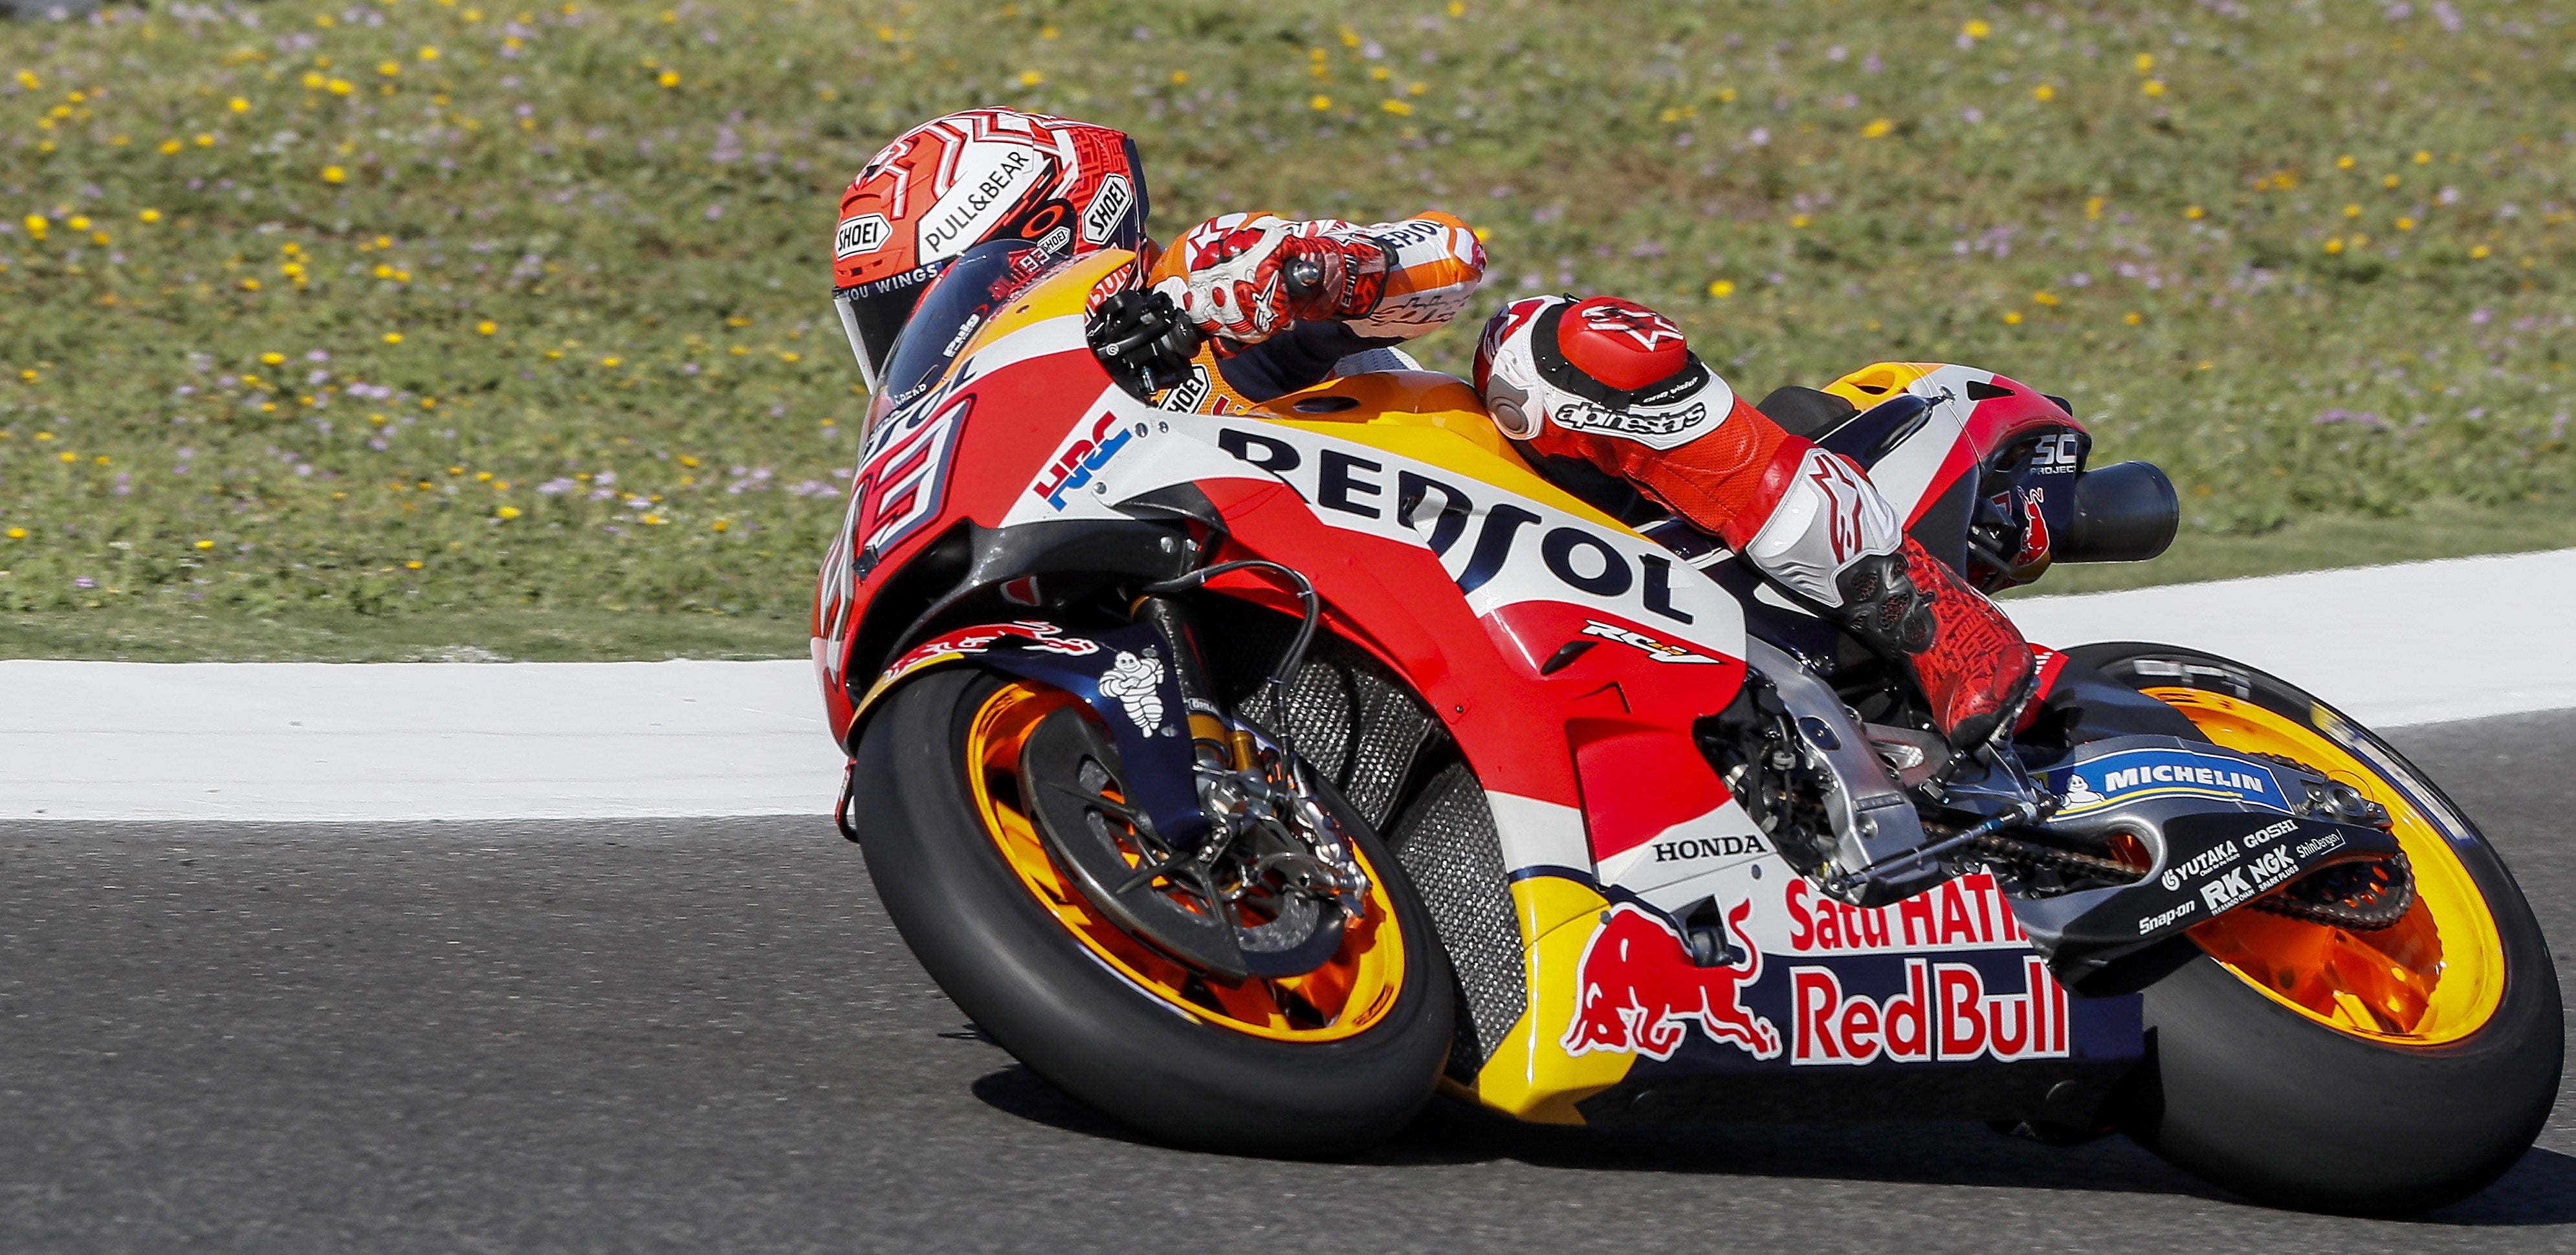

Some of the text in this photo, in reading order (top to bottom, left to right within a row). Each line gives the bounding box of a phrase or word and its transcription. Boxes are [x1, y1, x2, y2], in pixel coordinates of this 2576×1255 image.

[925, 151, 1029, 252] PULL&BEAR
[1090, 180, 1126, 236] SHOEI
[837, 221, 877, 252] SHOEI
[1019, 246, 1050, 272] 93
[875, 265, 938, 294] WINGS
[1167, 376, 1204, 413] HOEI
[1556, 402, 1706, 434] alpinestars
[1033, 410, 1133, 512] HRC
[2032, 434, 2077, 465] SC
[2105, 765, 2264, 794] MICHELIN
[1652, 835, 1767, 862] HONDA
[2177, 819, 2298, 881] YUTAKA GOSHI
[2199, 833, 2340, 911] RK NGK ShinDengen
[2258, 864, 2300, 892] SPARK PLUGS
[1785, 878, 1886, 952] Satu
[2139, 899, 2196, 936] Snap-on
[1794, 961, 2066, 1062] Red Bull
